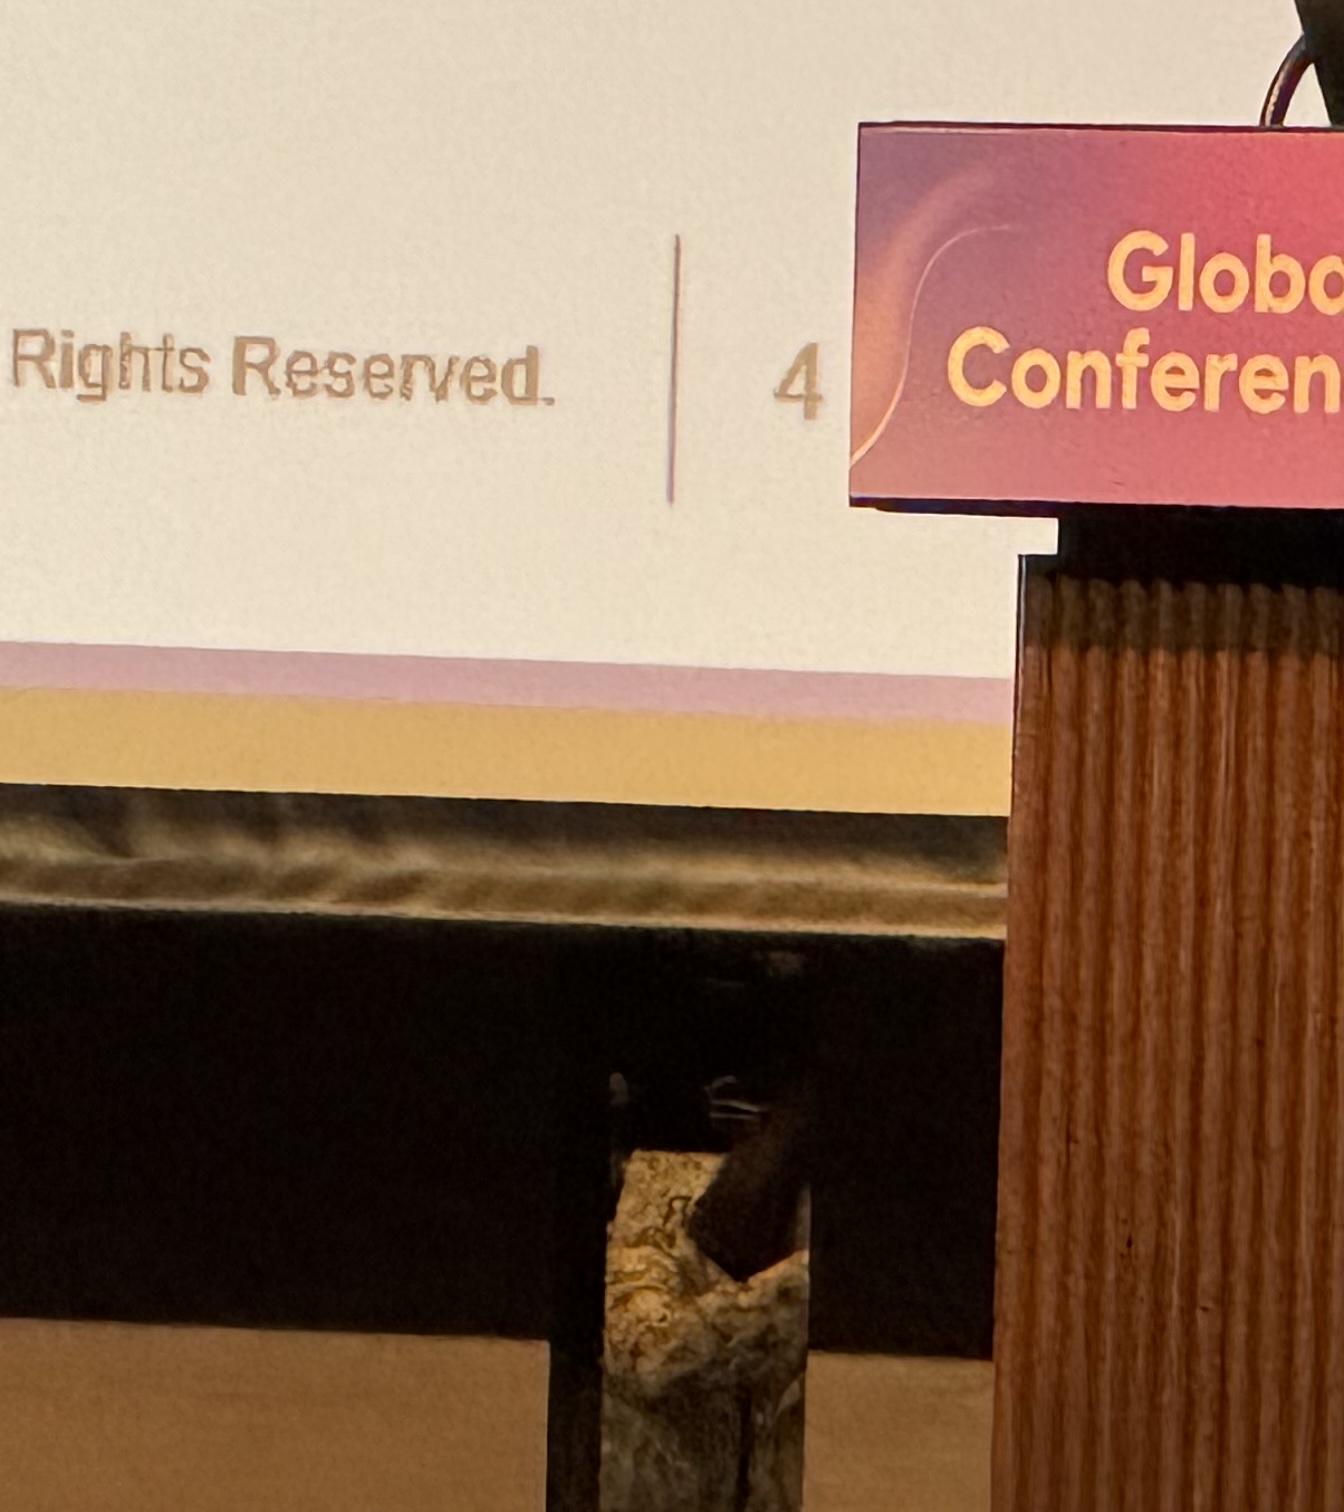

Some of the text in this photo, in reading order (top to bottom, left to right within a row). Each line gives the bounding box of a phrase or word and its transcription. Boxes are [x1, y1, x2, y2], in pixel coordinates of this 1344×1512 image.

[11, 328, 556, 408] Rights Reserved.
[772, 342, 824, 421] 4
